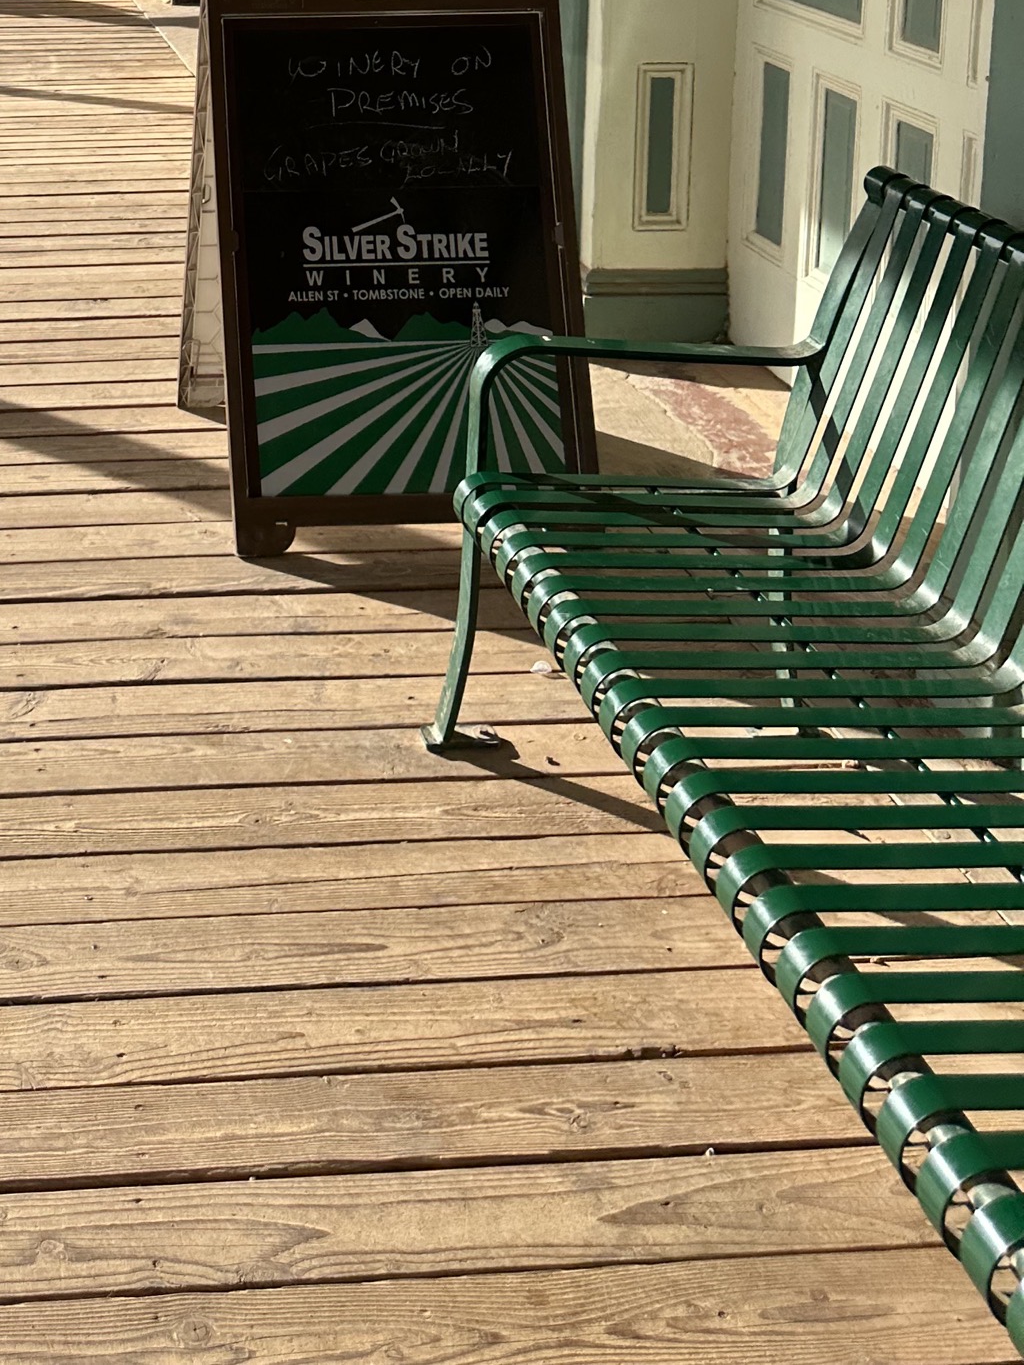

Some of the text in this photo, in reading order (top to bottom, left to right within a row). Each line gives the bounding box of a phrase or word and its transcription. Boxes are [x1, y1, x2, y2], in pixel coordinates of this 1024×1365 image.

[288, 45, 492, 84] WINERY ON
[327, 88, 474, 117] PREMISES
[264, 130, 459, 181] GRAPES GROWN
[302, 224, 489, 261] SILVER STRIKE
[306, 267, 489, 286] WINERY
[288, 286, 510, 302] ALLEN ST TOMBSTONE OPEN DAILY
